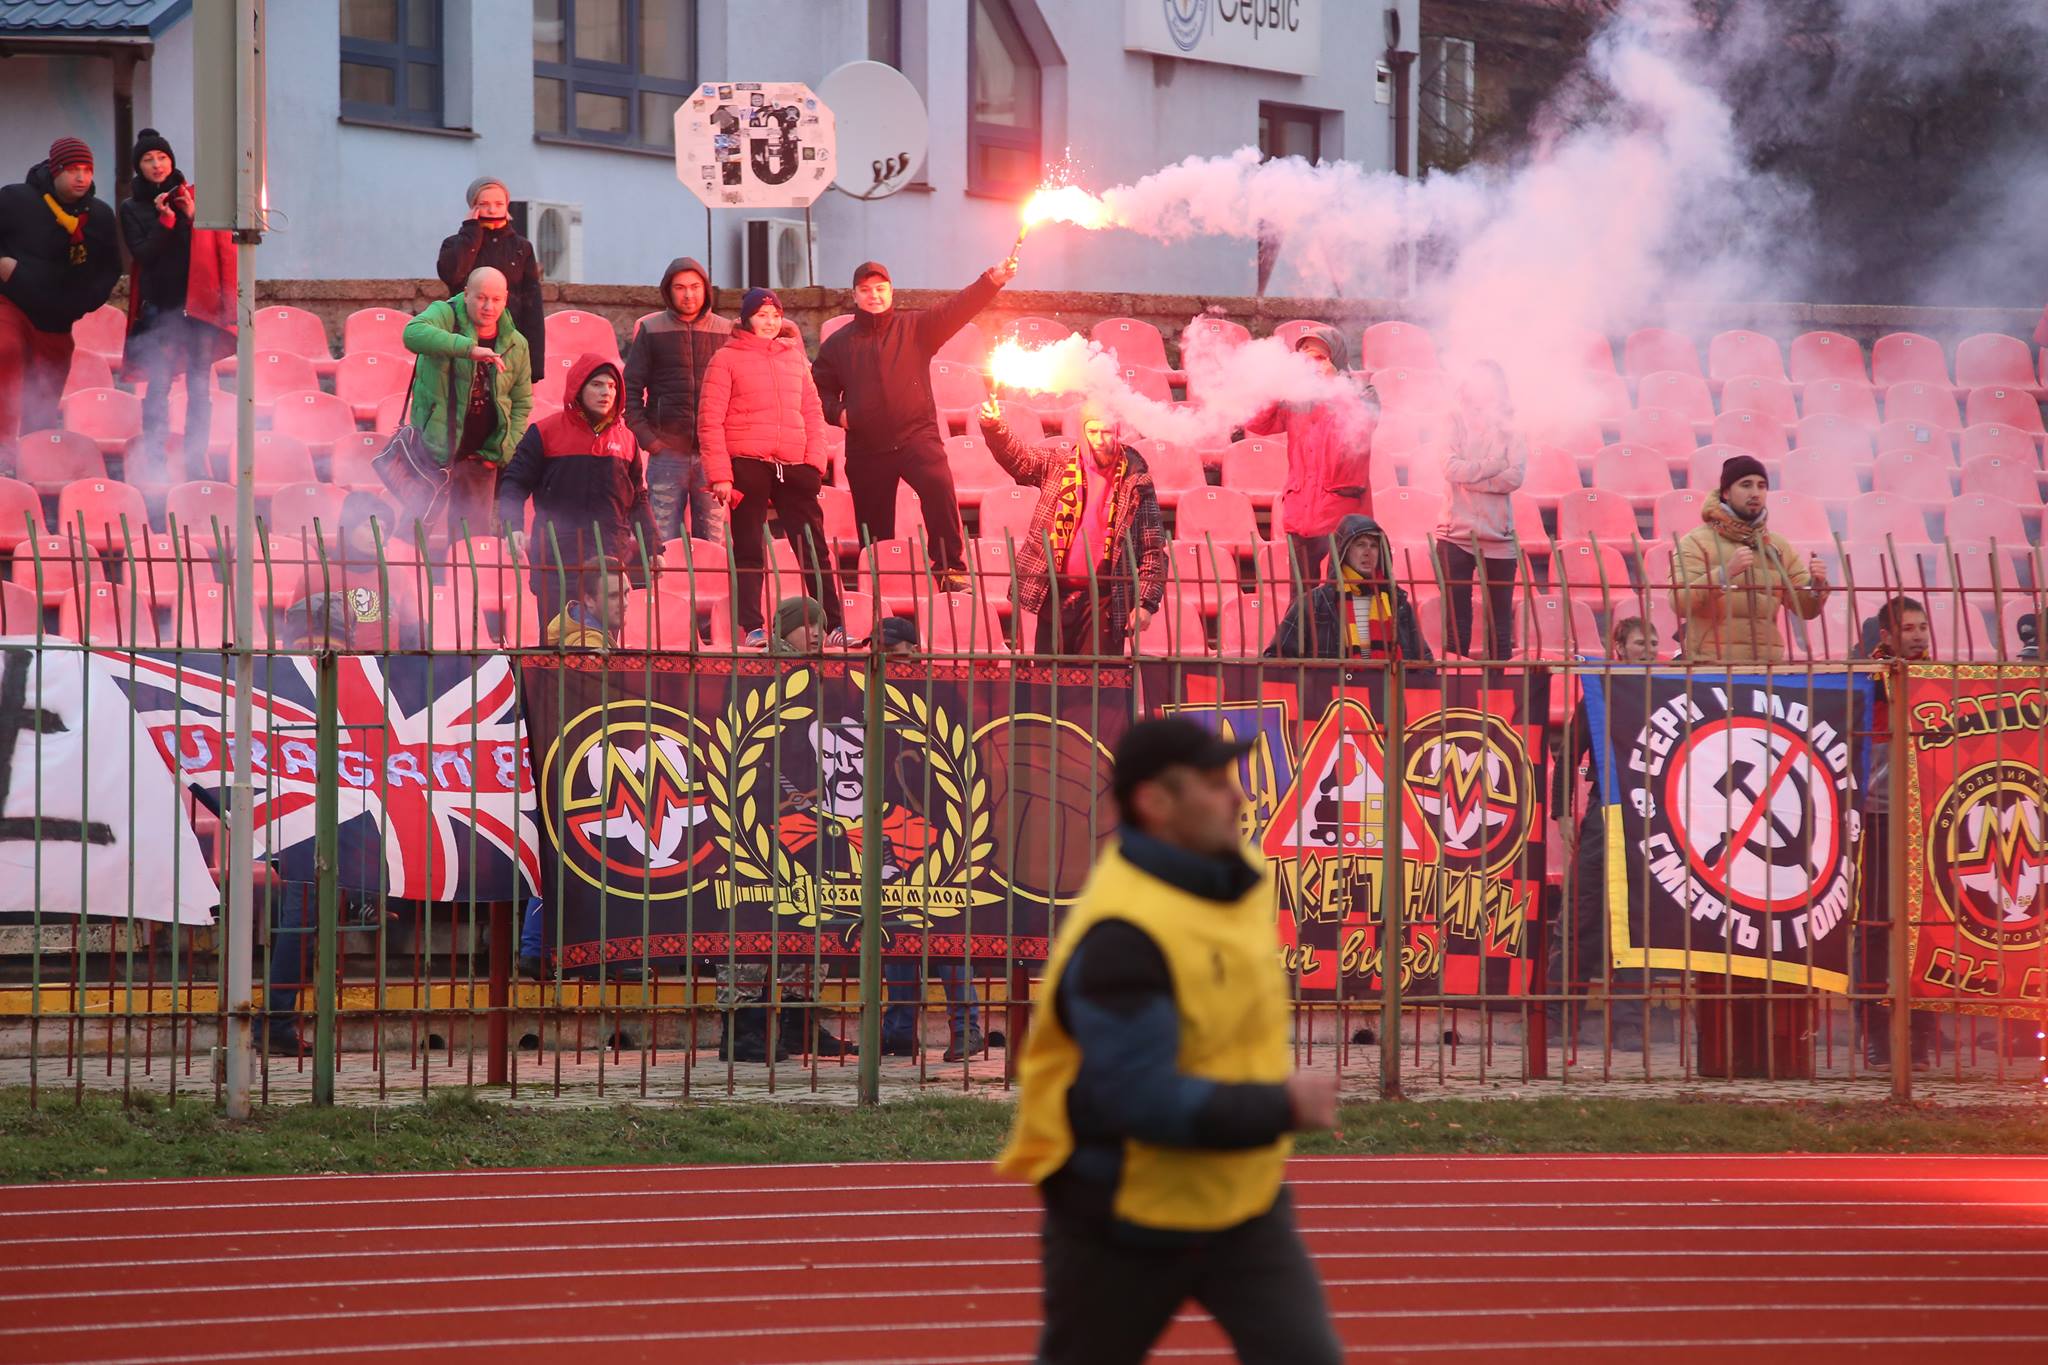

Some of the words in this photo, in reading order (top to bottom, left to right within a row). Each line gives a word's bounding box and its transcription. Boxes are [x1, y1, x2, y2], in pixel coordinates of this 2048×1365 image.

[491, 744, 535, 788] 8
[1629, 692, 1704, 776] СЕРП
[1941, 770, 2027, 828] ФУБОЛЬИЙ
[819, 888, 902, 902] КОЗАКА
[907, 889, 975, 905] МЛОД
[1263, 849, 1533, 957] КЕТНИКИ
[1639, 832, 1760, 950] СМЕРТЬ
